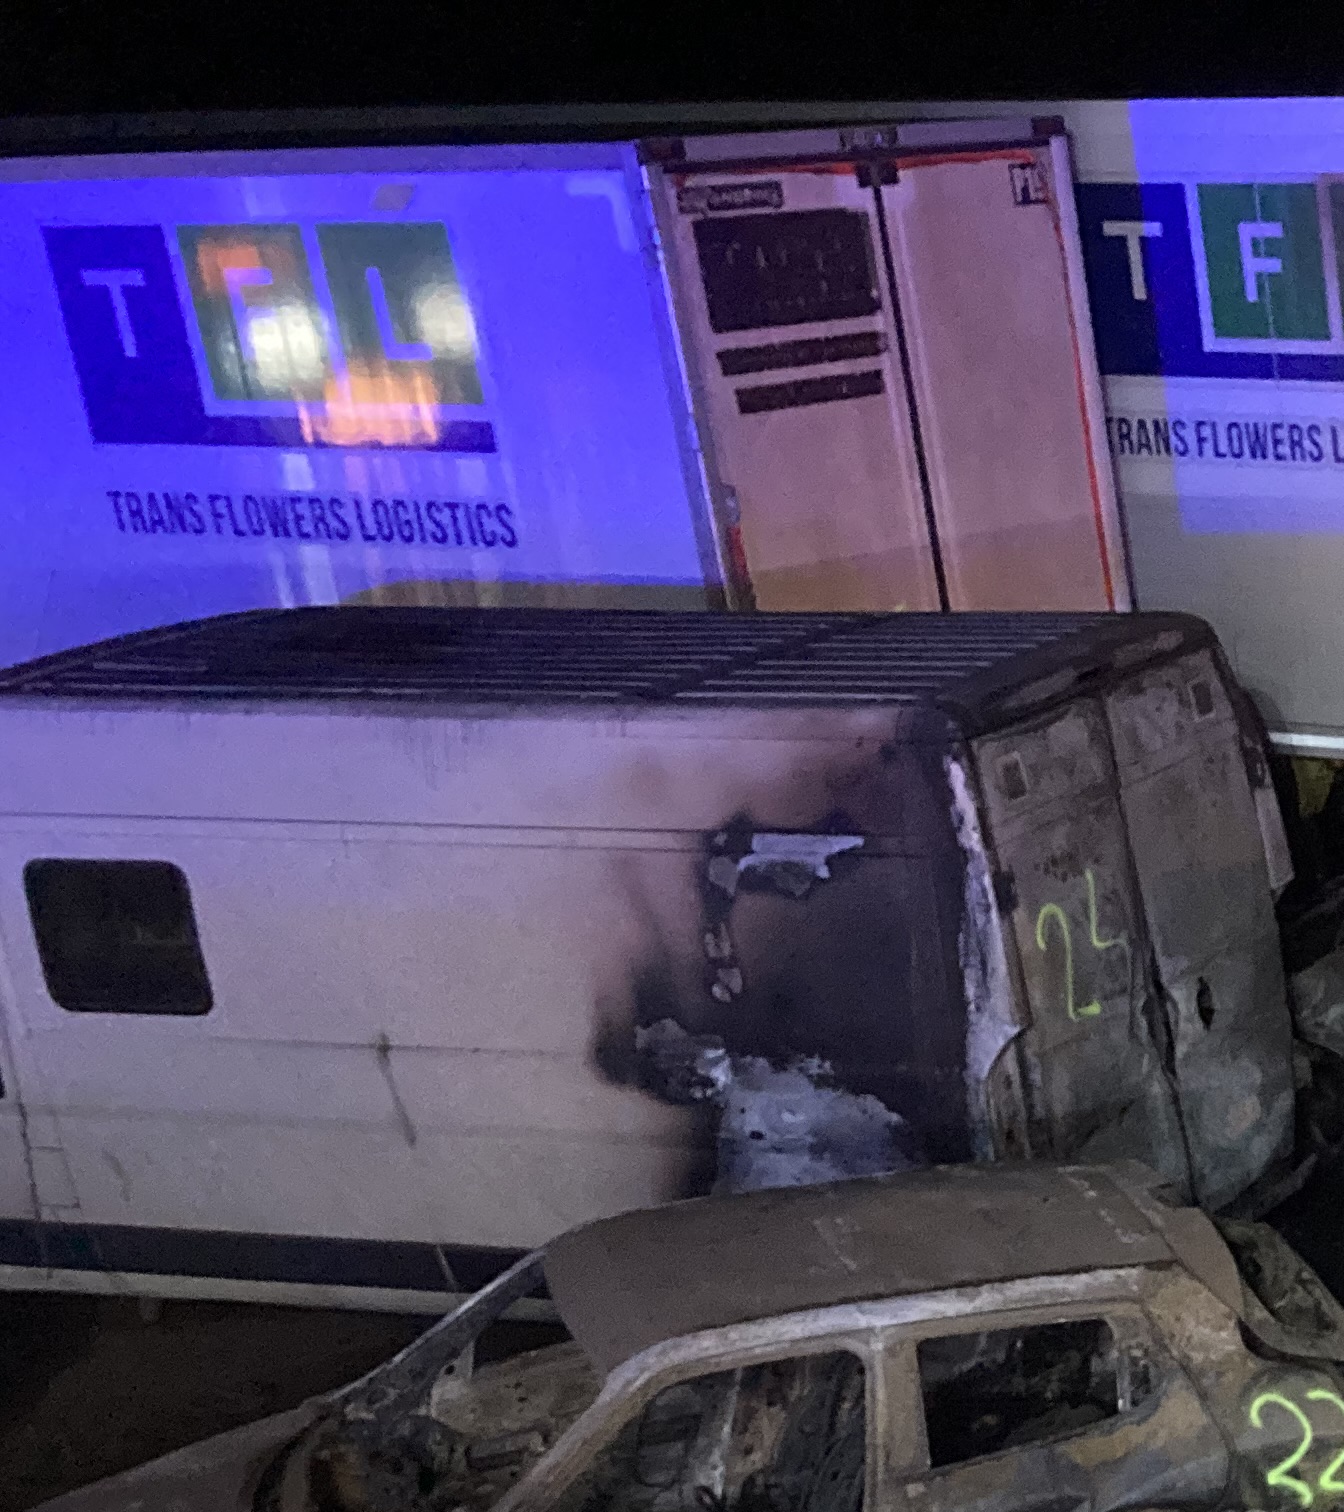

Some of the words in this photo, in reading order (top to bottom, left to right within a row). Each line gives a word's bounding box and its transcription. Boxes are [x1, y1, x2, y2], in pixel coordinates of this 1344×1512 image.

[1107, 416, 1189, 457] TRANS
[1194, 420, 1326, 462] FLOWERS
[107, 491, 206, 536] TRANS
[209, 495, 350, 541] FLOWERS
[354, 499, 518, 547] LOGISTICS
